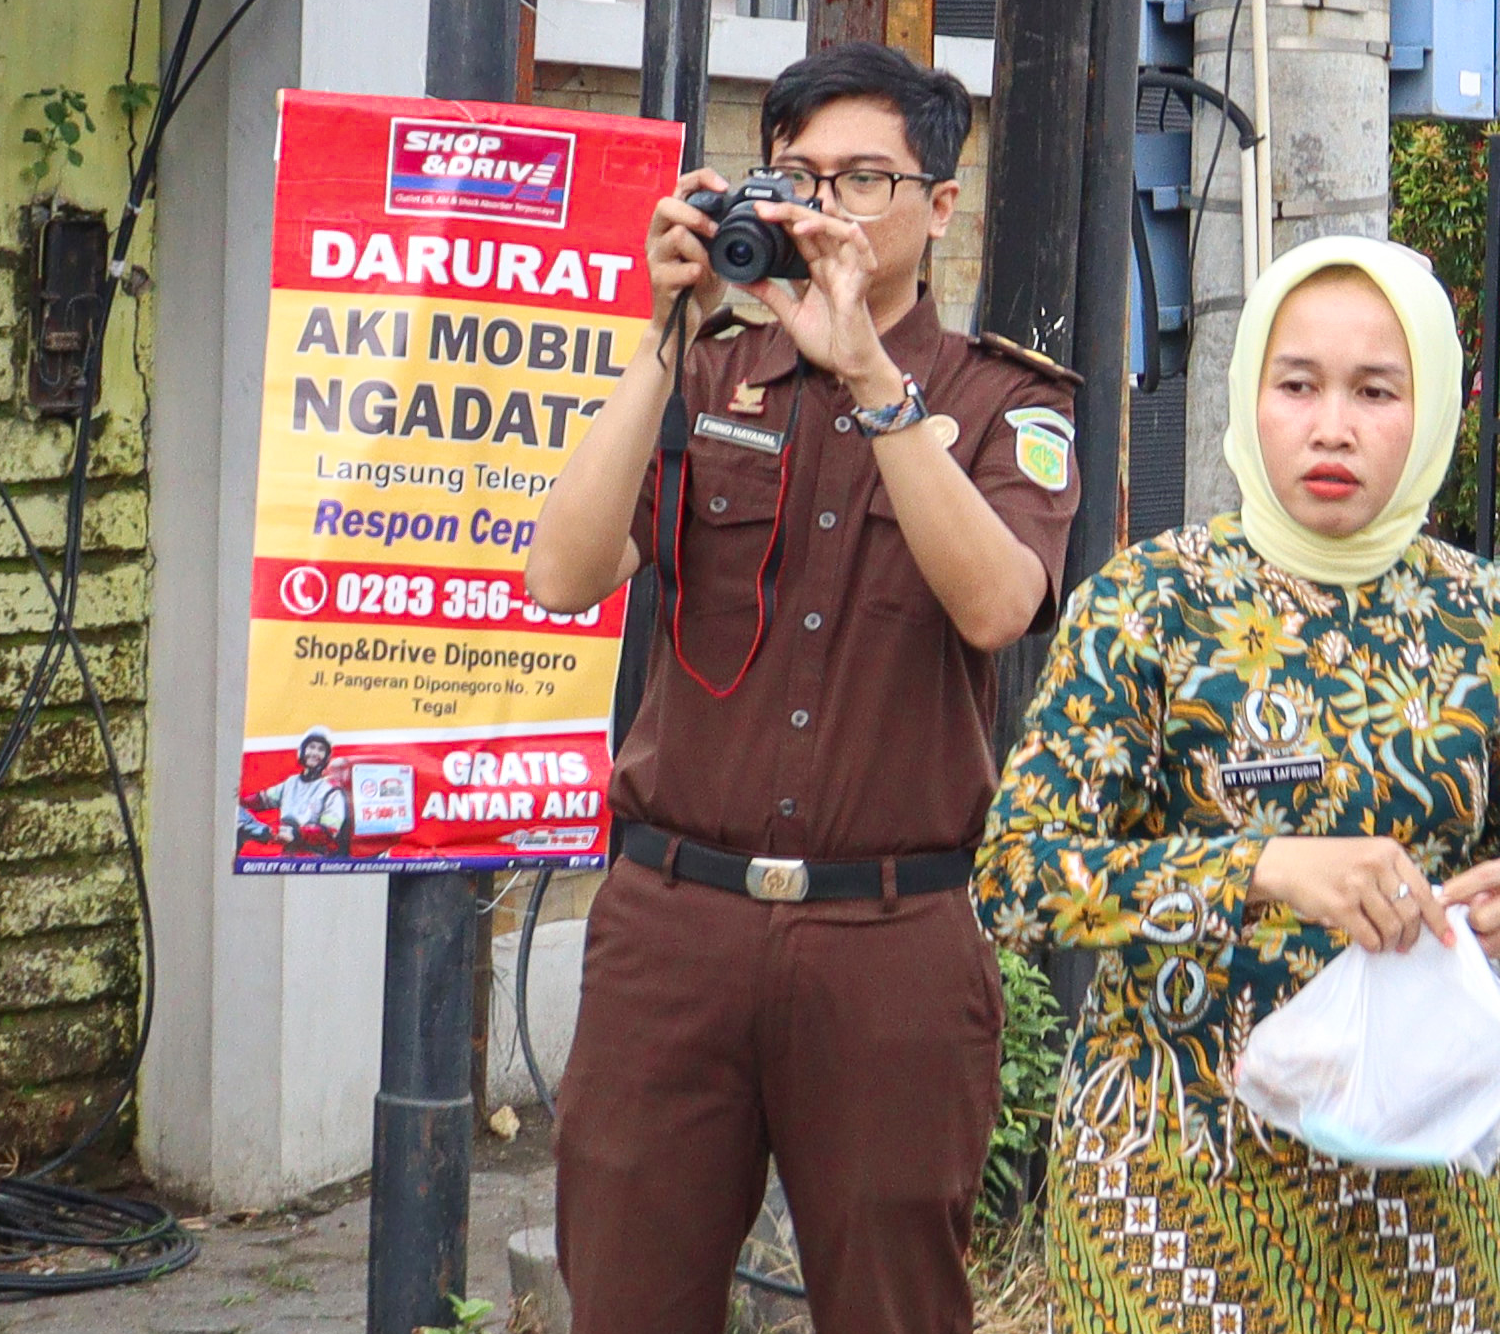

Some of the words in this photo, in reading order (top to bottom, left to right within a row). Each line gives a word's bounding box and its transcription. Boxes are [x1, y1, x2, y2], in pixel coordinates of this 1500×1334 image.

[404, 131, 501, 155] SHOP
[422, 154, 556, 185] &DRIVE
[311, 229, 633, 302] DARURAT
[296, 307, 409, 358] AKI
[429, 313, 628, 378] MOBIL
[317, 454, 464, 493] Langsung
[474, 464, 558, 498] Telep
[313, 499, 459, 546] Respon
[470, 508, 536, 554] Cep
[336, 573, 435, 616] 0283
[294, 635, 436, 665] Shop&Drive
[445, 643, 577, 674] Diponegoro
[334, 673, 408, 691] Pangeran
[414, 677, 502, 695] Diponegoro
[505, 680, 527, 695] No.
[534, 681, 555, 695] 79
[412, 698, 457, 717] Tegal
[443, 751, 590, 787] GRATIS
[421, 791, 534, 821] ANTAR
[542, 791, 599, 819] AKI
